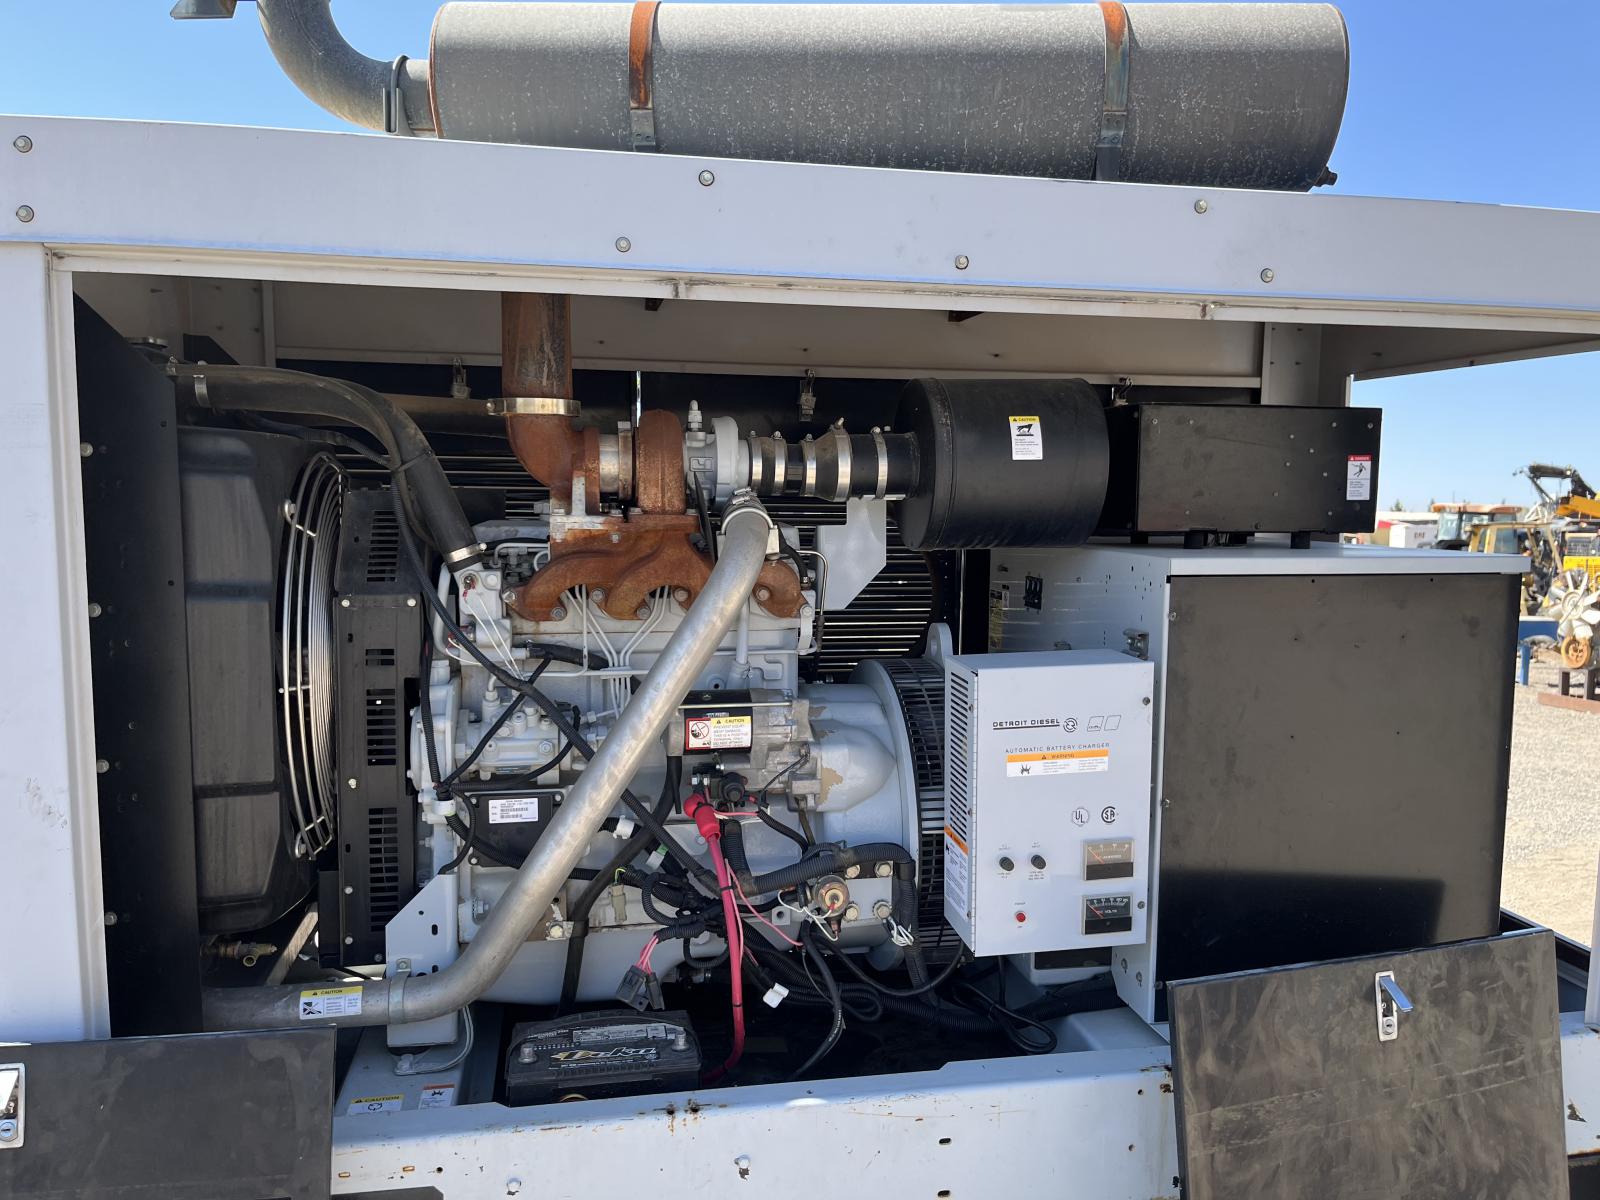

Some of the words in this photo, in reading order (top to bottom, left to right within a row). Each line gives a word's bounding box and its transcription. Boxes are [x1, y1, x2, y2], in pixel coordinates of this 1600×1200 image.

[992, 720, 1028, 728] DETROIT
[1030, 718, 1060, 726] DIESEL
[1005, 746, 1044, 754] AUTOMATIC
[1046, 744, 1076, 752] BATTERY
